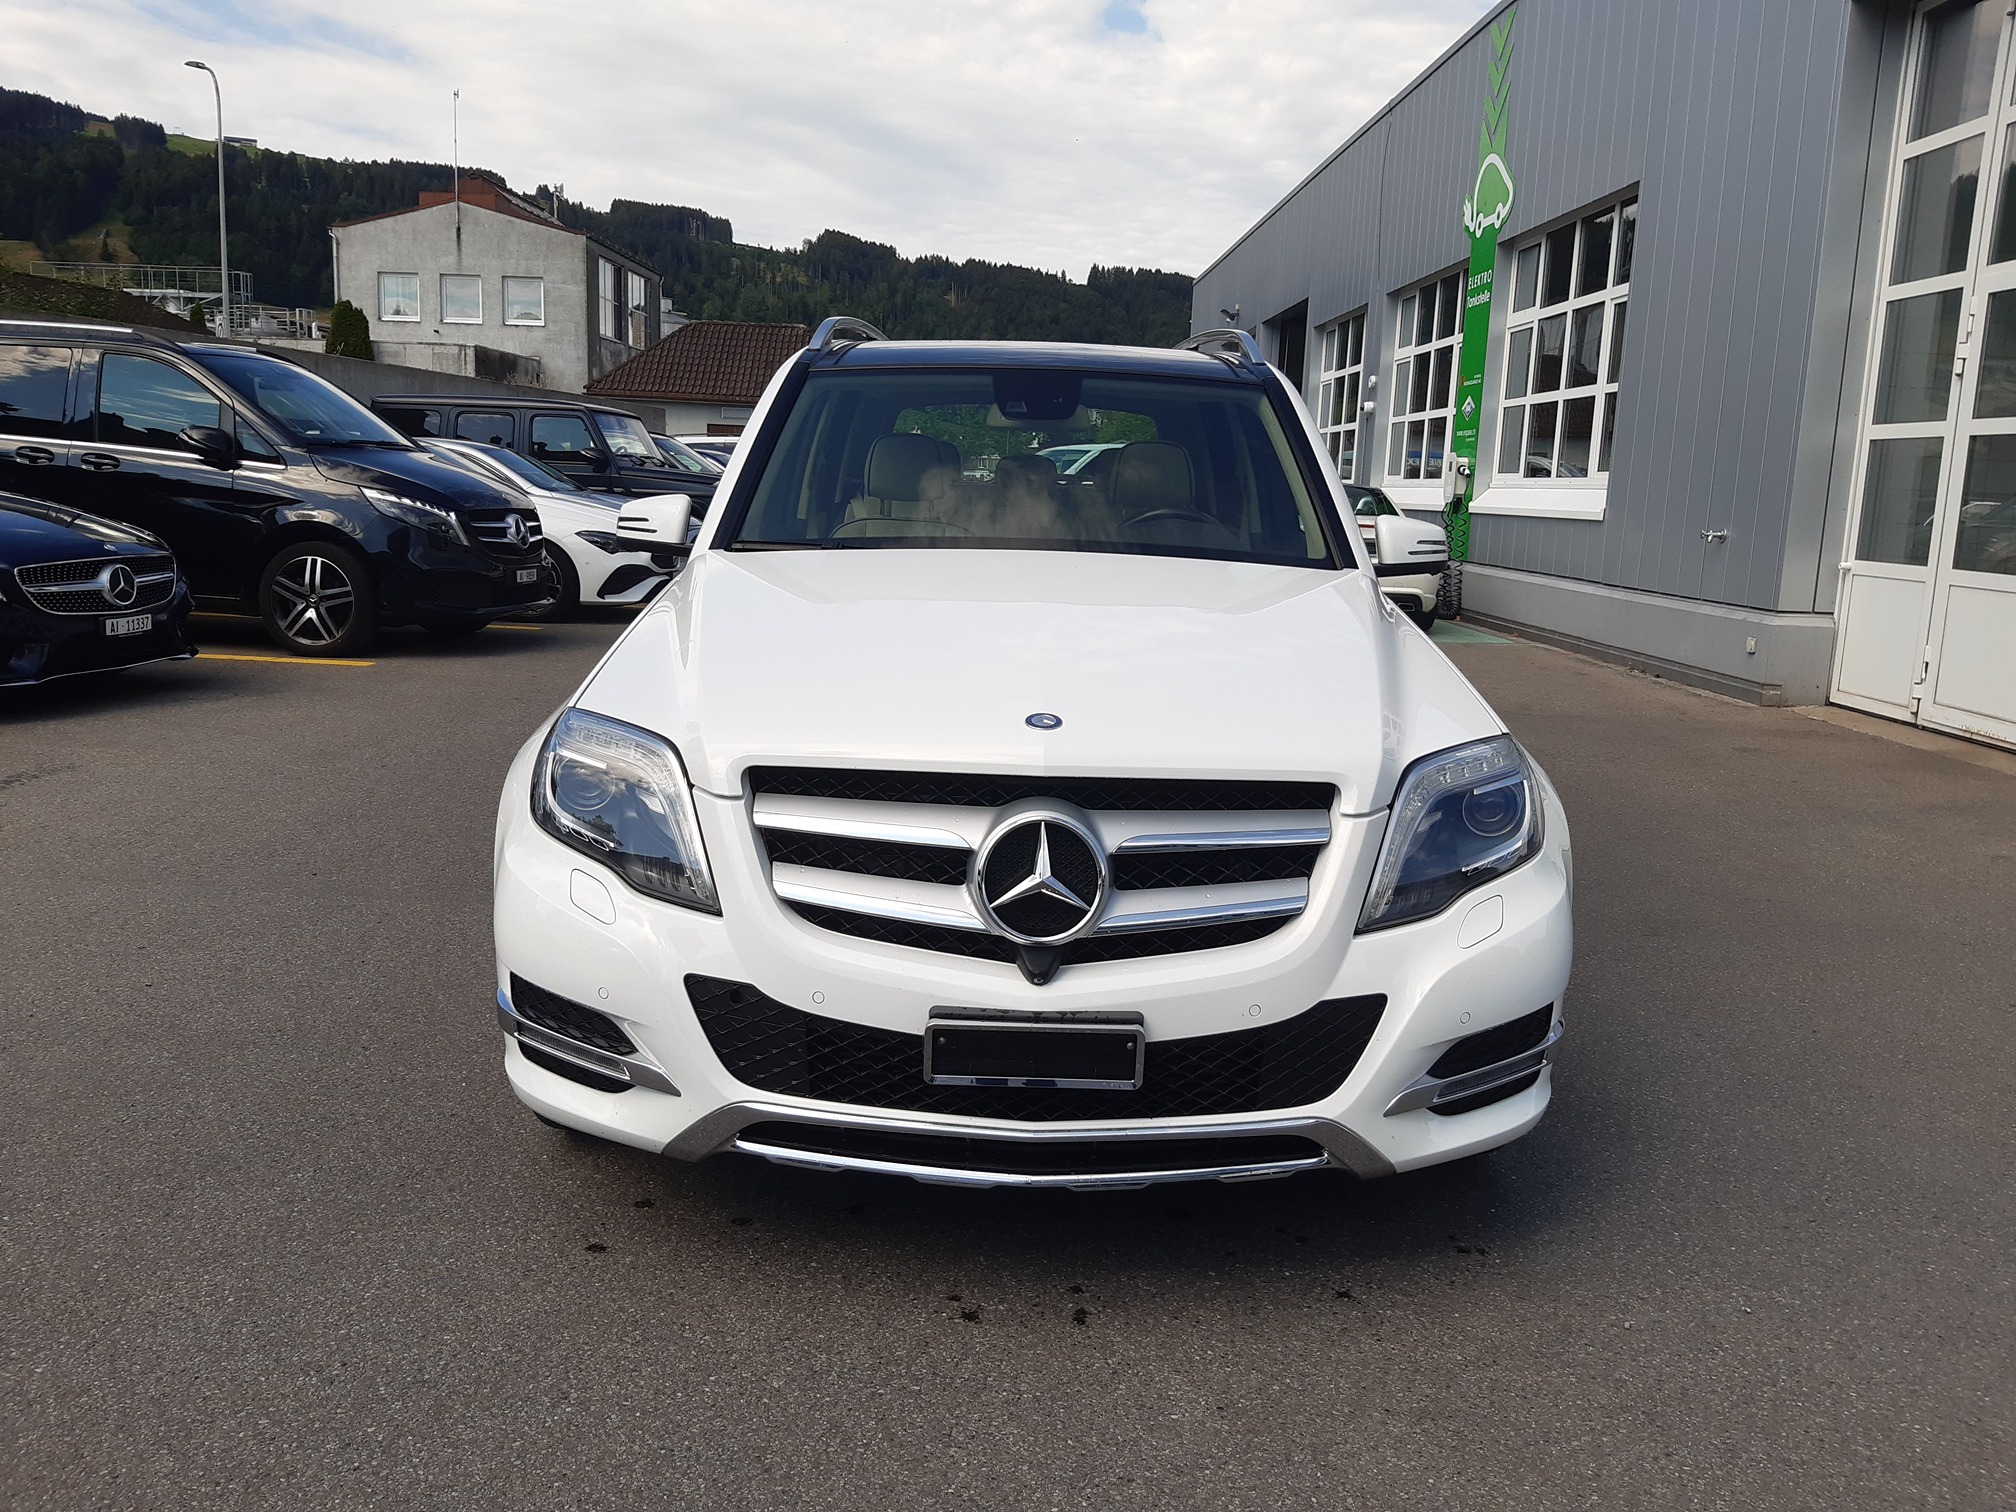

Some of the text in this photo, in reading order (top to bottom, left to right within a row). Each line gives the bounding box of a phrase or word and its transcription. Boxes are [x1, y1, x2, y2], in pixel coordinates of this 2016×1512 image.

[1468, 269, 1493, 290] ELEKTRO
[110, 616, 150, 634] AI 11337
